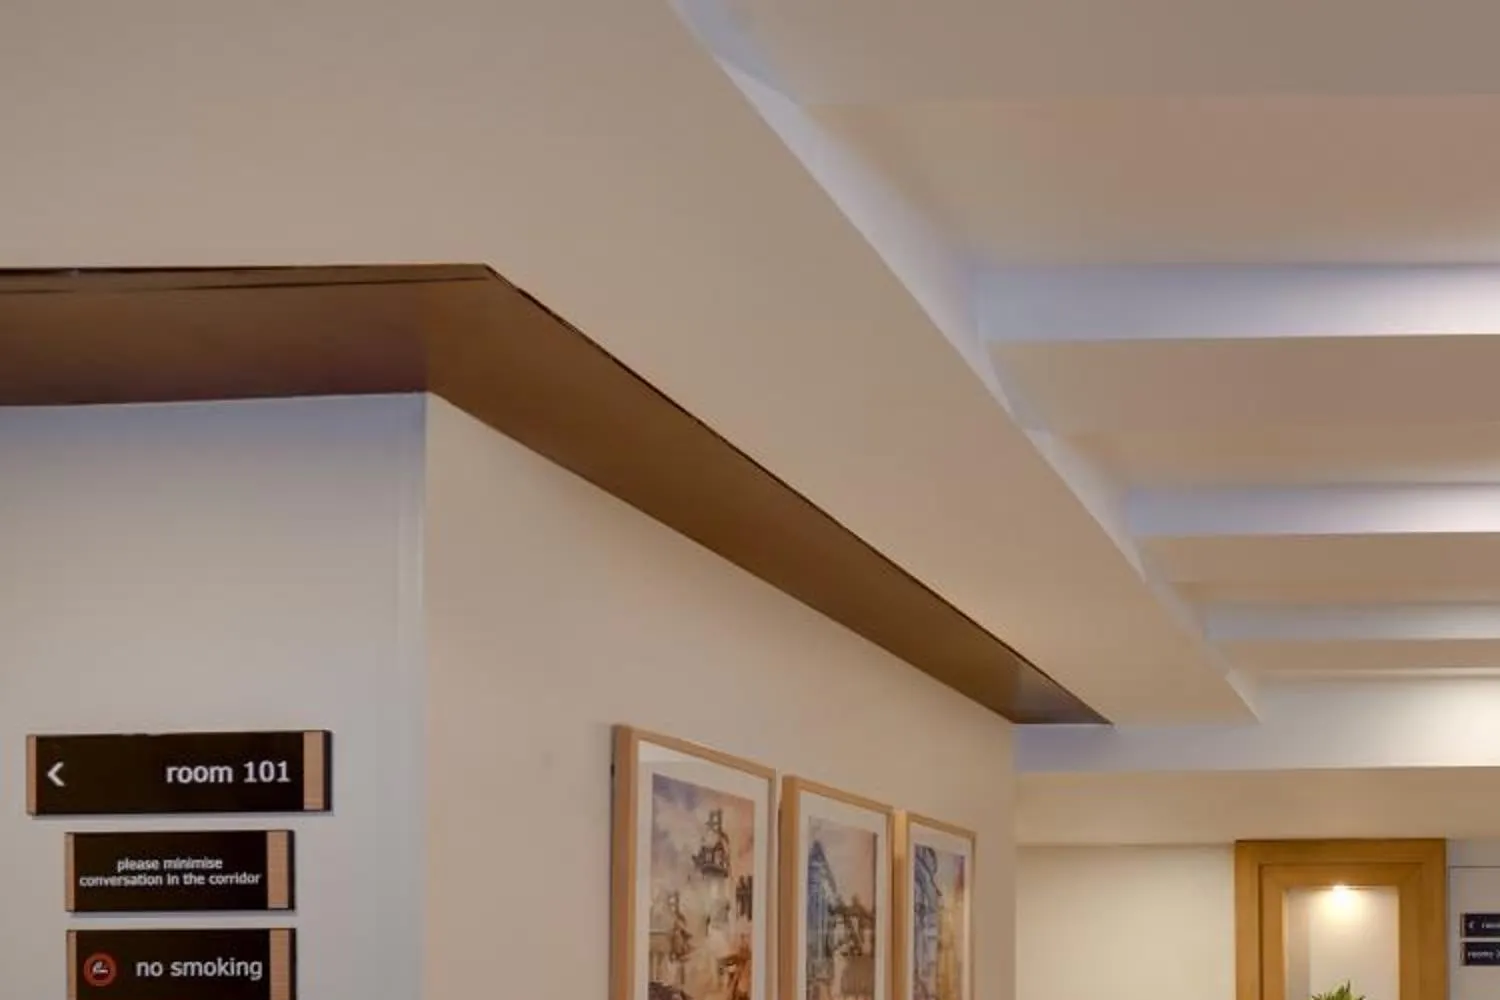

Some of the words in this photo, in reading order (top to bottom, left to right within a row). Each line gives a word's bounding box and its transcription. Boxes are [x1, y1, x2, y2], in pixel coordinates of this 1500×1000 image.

[166, 765, 233, 784] room
[243, 760, 290, 783] 101
[116, 857, 160, 873] please
[163, 857, 223, 869] minimise
[79, 873, 163, 887] conversation
[166, 873, 180, 885] in
[183, 872, 206, 885] the
[208, 871, 262, 885] corridor
[135, 962, 164, 977] no
[170, 957, 263, 981] smoking
